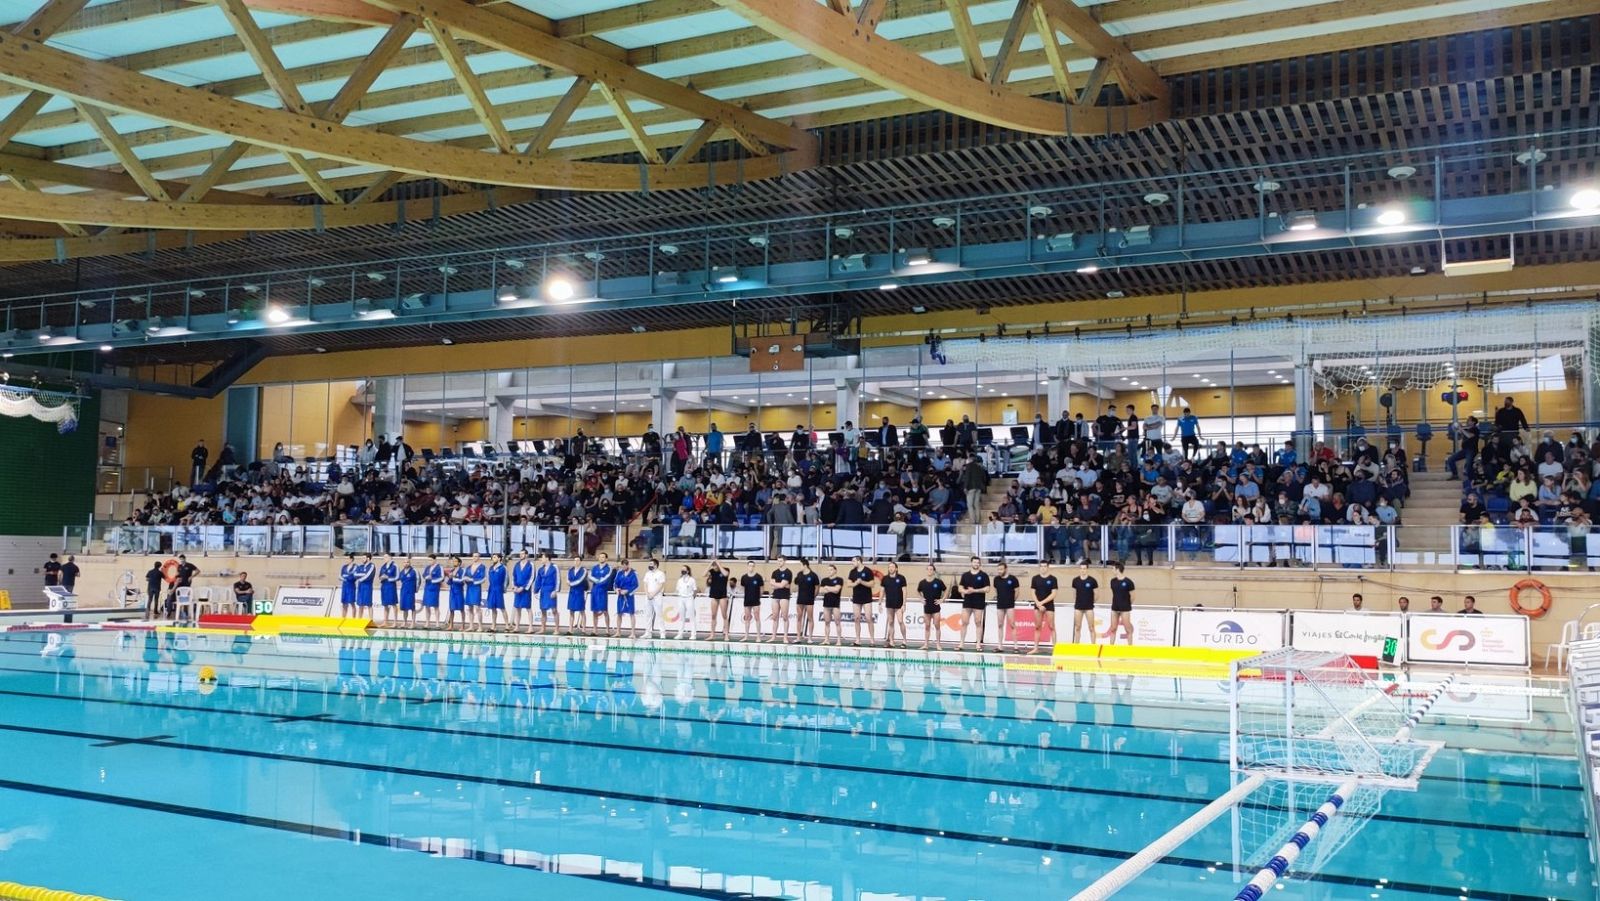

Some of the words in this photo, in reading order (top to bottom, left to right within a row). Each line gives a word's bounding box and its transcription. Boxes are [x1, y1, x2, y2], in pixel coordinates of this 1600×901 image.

[255, 601, 272, 613] 30
[1201, 634, 1258, 645] TURBO
[1383, 639, 1397, 656] 30
